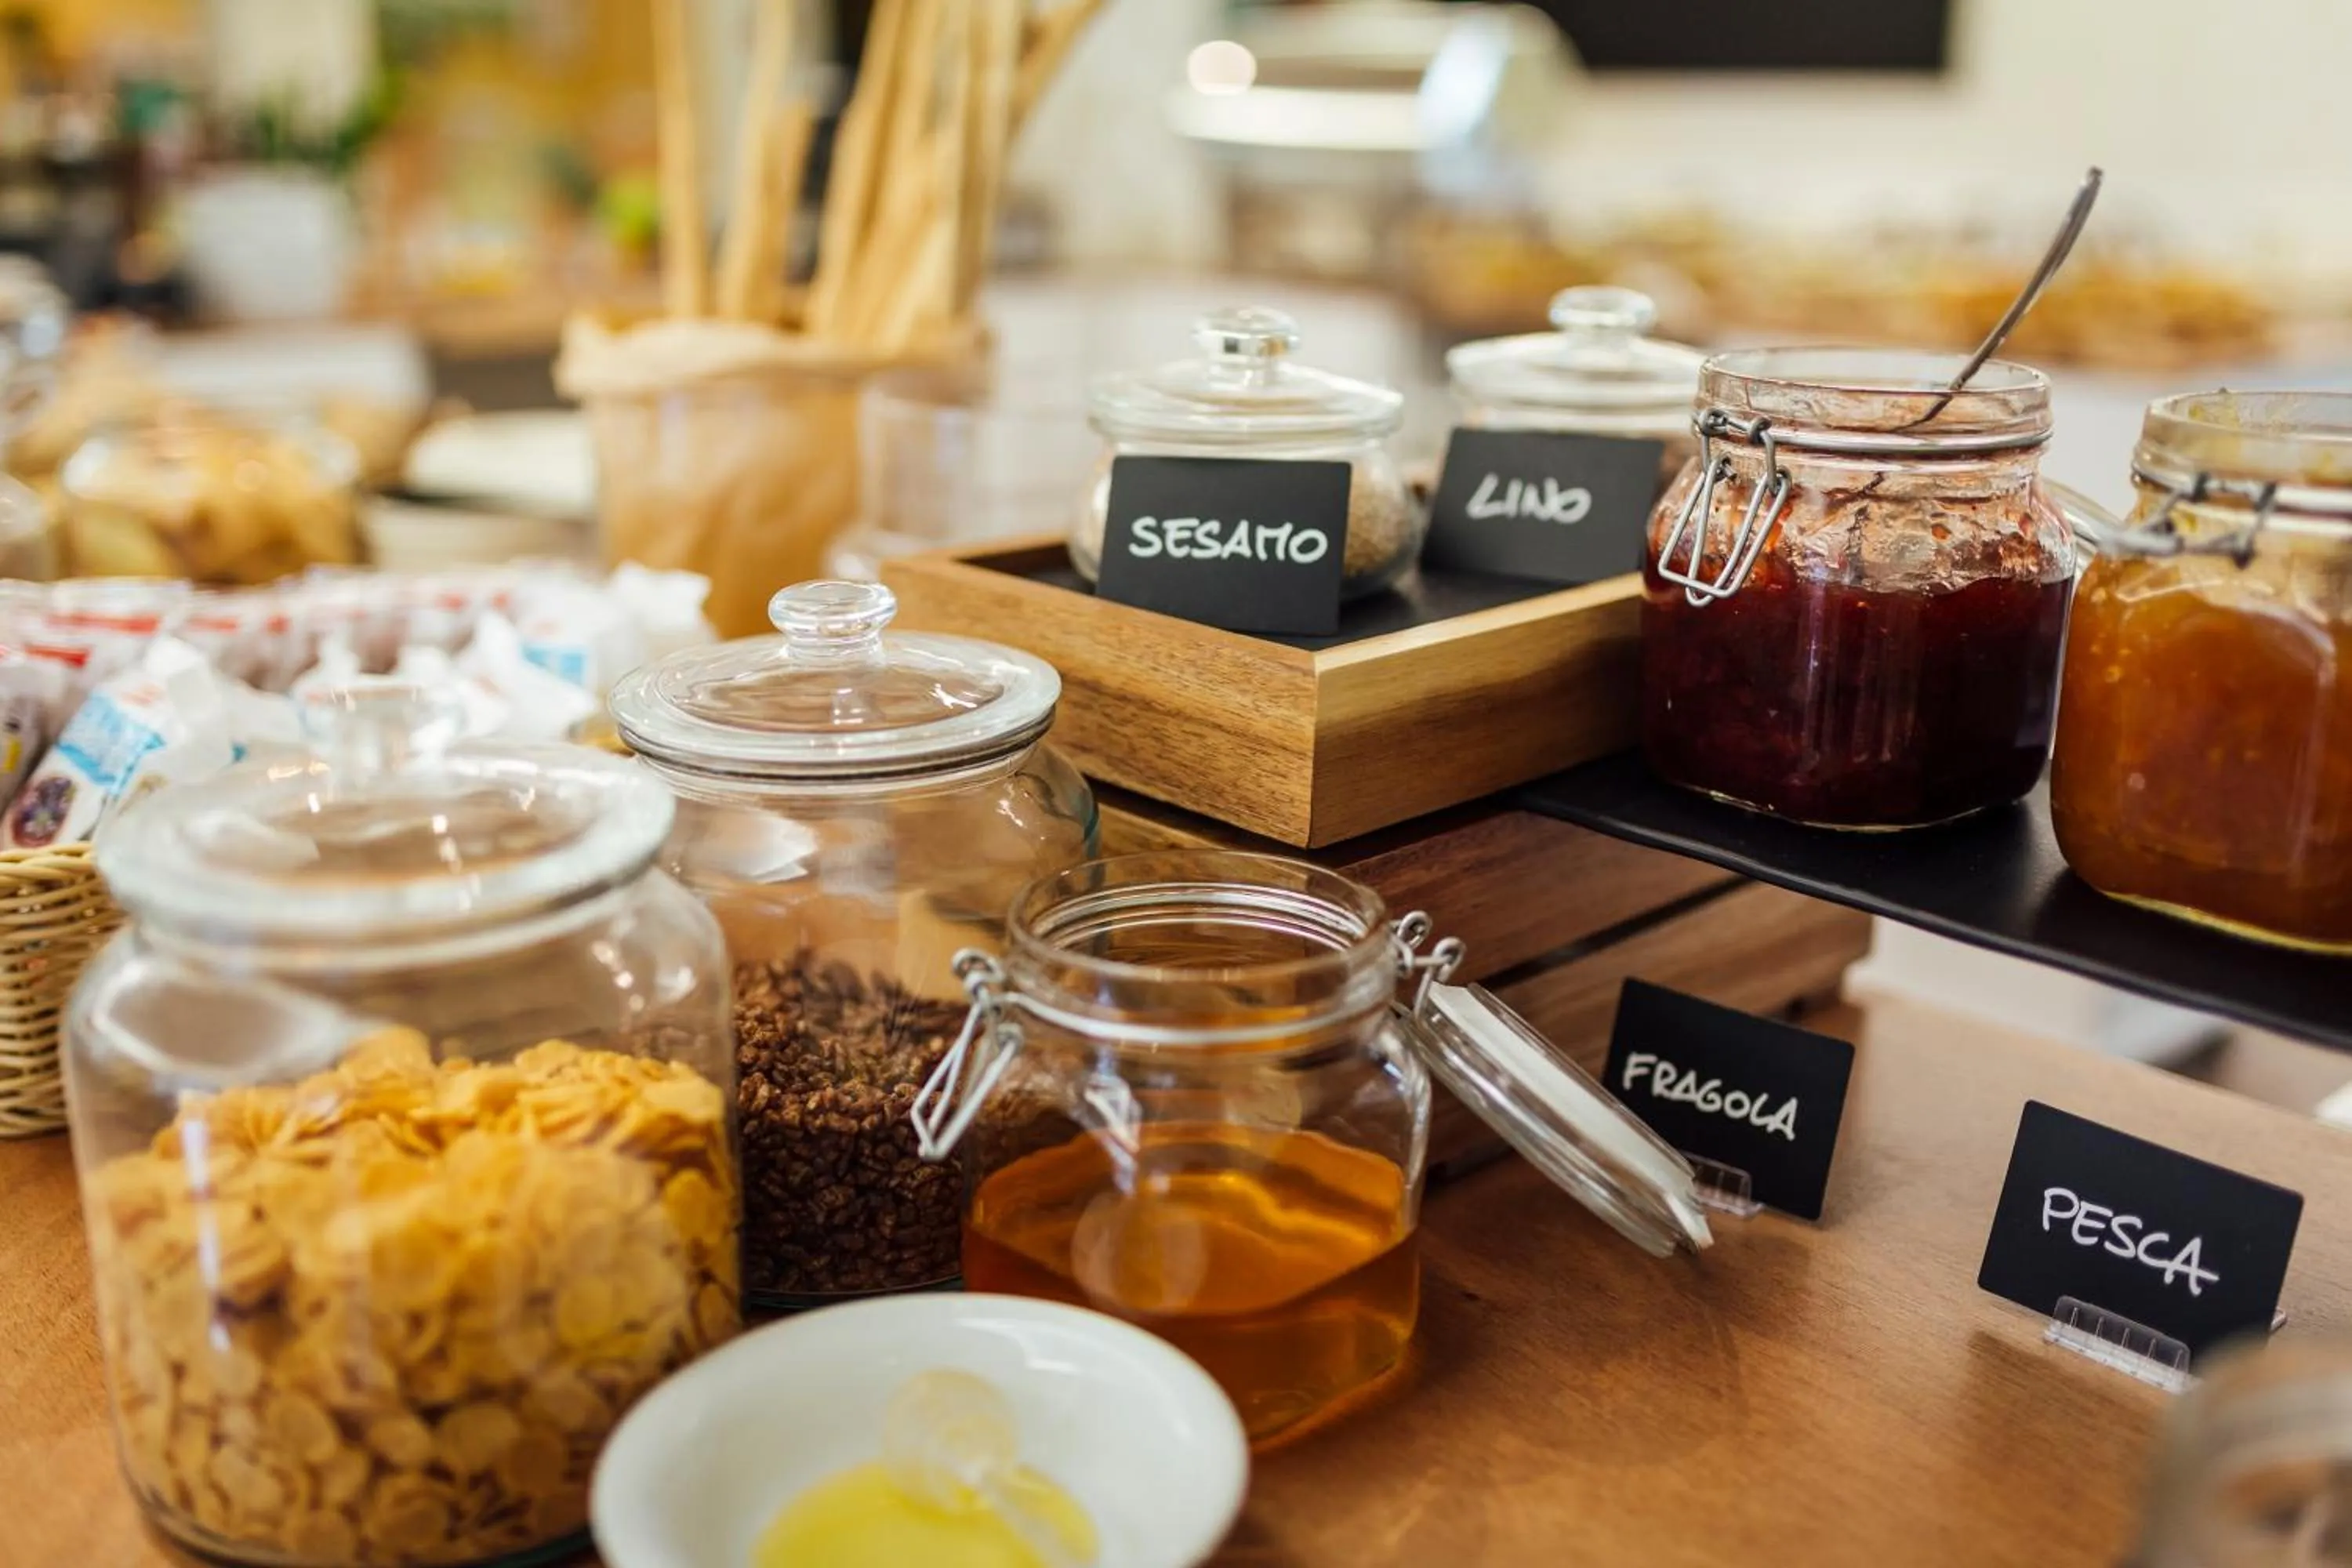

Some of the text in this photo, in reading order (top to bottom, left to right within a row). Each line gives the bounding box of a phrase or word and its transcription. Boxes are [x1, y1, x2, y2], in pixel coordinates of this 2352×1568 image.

[1466, 472, 1593, 524] LINO
[1128, 515, 1329, 564] SESAMO
[1622, 1051, 1798, 1142] FRAGOLA
[2042, 1186, 2220, 1297] PESCA
